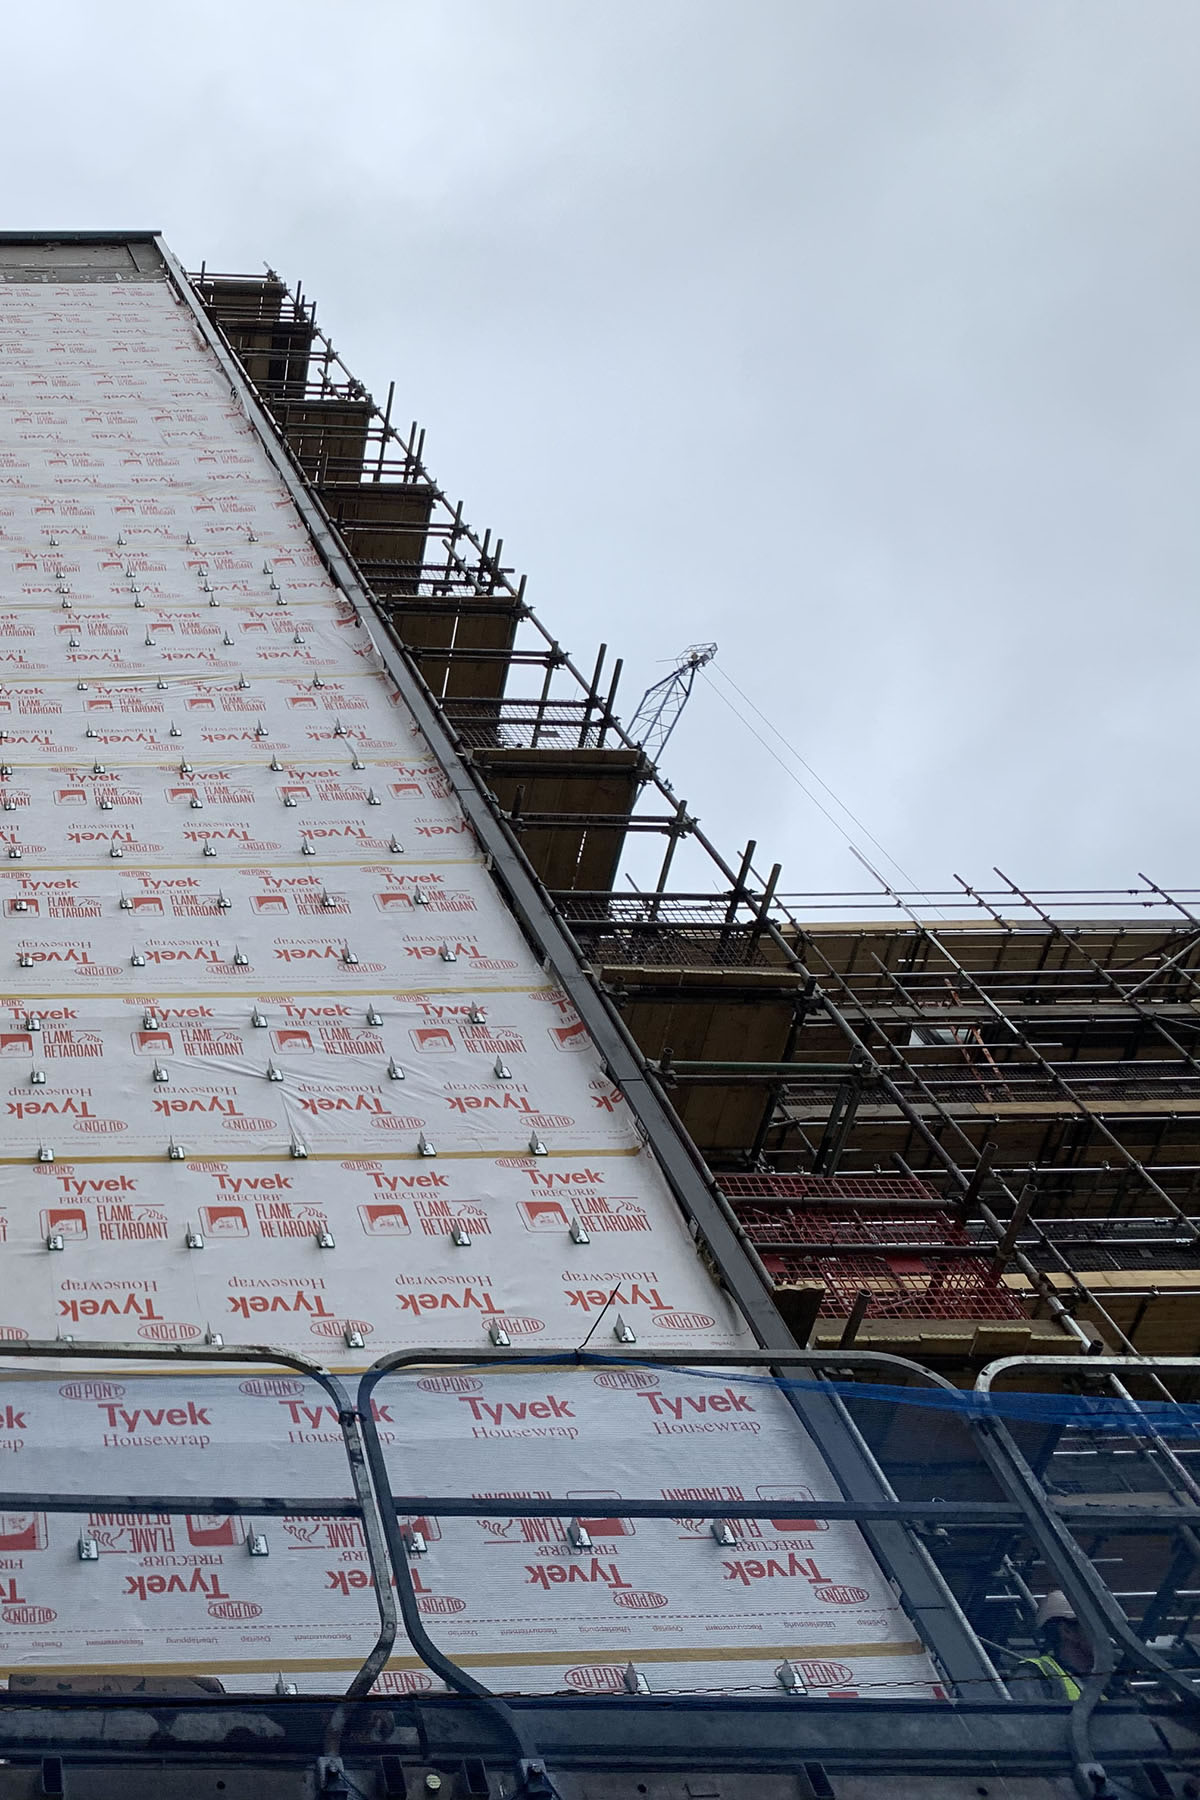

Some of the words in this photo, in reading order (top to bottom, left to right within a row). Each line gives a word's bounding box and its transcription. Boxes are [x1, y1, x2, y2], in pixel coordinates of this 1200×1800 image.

[69, 771, 121, 783] Tyvek
[284, 768, 339, 780] Tyvek
[184, 829, 252, 842] Tyvek
[300, 826, 369, 841] Tyvek
[139, 876, 199, 889] Tyvek
[383, 871, 443, 885] Tyvek
[146, 947, 221, 963] Tyvek
[10, 1008, 76, 1019] Tyvek
[148, 1005, 213, 1021] Tyvek
[45, 1031, 78, 1046] FLAME
[44, 1040, 103, 1057] RETARDANT
[8, 1098, 96, 1120] Tyvek
[152, 1096, 242, 1116] Tyvek
[300, 1095, 390, 1115] Tyvek
[446, 1093, 539, 1114] Tyvek
[62, 1176, 136, 1195] Tyvek
[214, 1174, 291, 1192] Tyvek
[368, 1172, 448, 1190] Tyvek
[525, 1169, 602, 1188] Tyvek
[97, 1205, 131, 1220] FLAME
[417, 1201, 450, 1216] FLAME
[572, 1197, 608, 1214] FLAME
[99, 1220, 168, 1240] RETARDANT
[580, 1211, 650, 1232] RETARDANT
[60, 1280, 158, 1292] Housewrap
[229, 1276, 325, 1289] Housewrap
[397, 1275, 492, 1287] Housewrap
[564, 1272, 658, 1283] Housewrap
[228, 1291, 333, 1318] Tyvek
[397, 1288, 504, 1315] Tyvek
[565, 1284, 672, 1312] Tyvek
[59, 1294, 162, 1322] Tyvek
[459, 1395, 574, 1424] Tyvek
[638, 1388, 752, 1419] Tyvek
[99, 1401, 211, 1432] Tyvek
[472, 1427, 579, 1439] Housewrap
[653, 1421, 760, 1435] Housewrap
[102, 1432, 211, 1448] Housewrap
[515, 1518, 566, 1542] FLAME
[128, 1528, 174, 1552] FLAME
[524, 1561, 632, 1590] Tyvek
[723, 1554, 831, 1586] Tyvek
[126, 1568, 228, 1600] Tyvek
